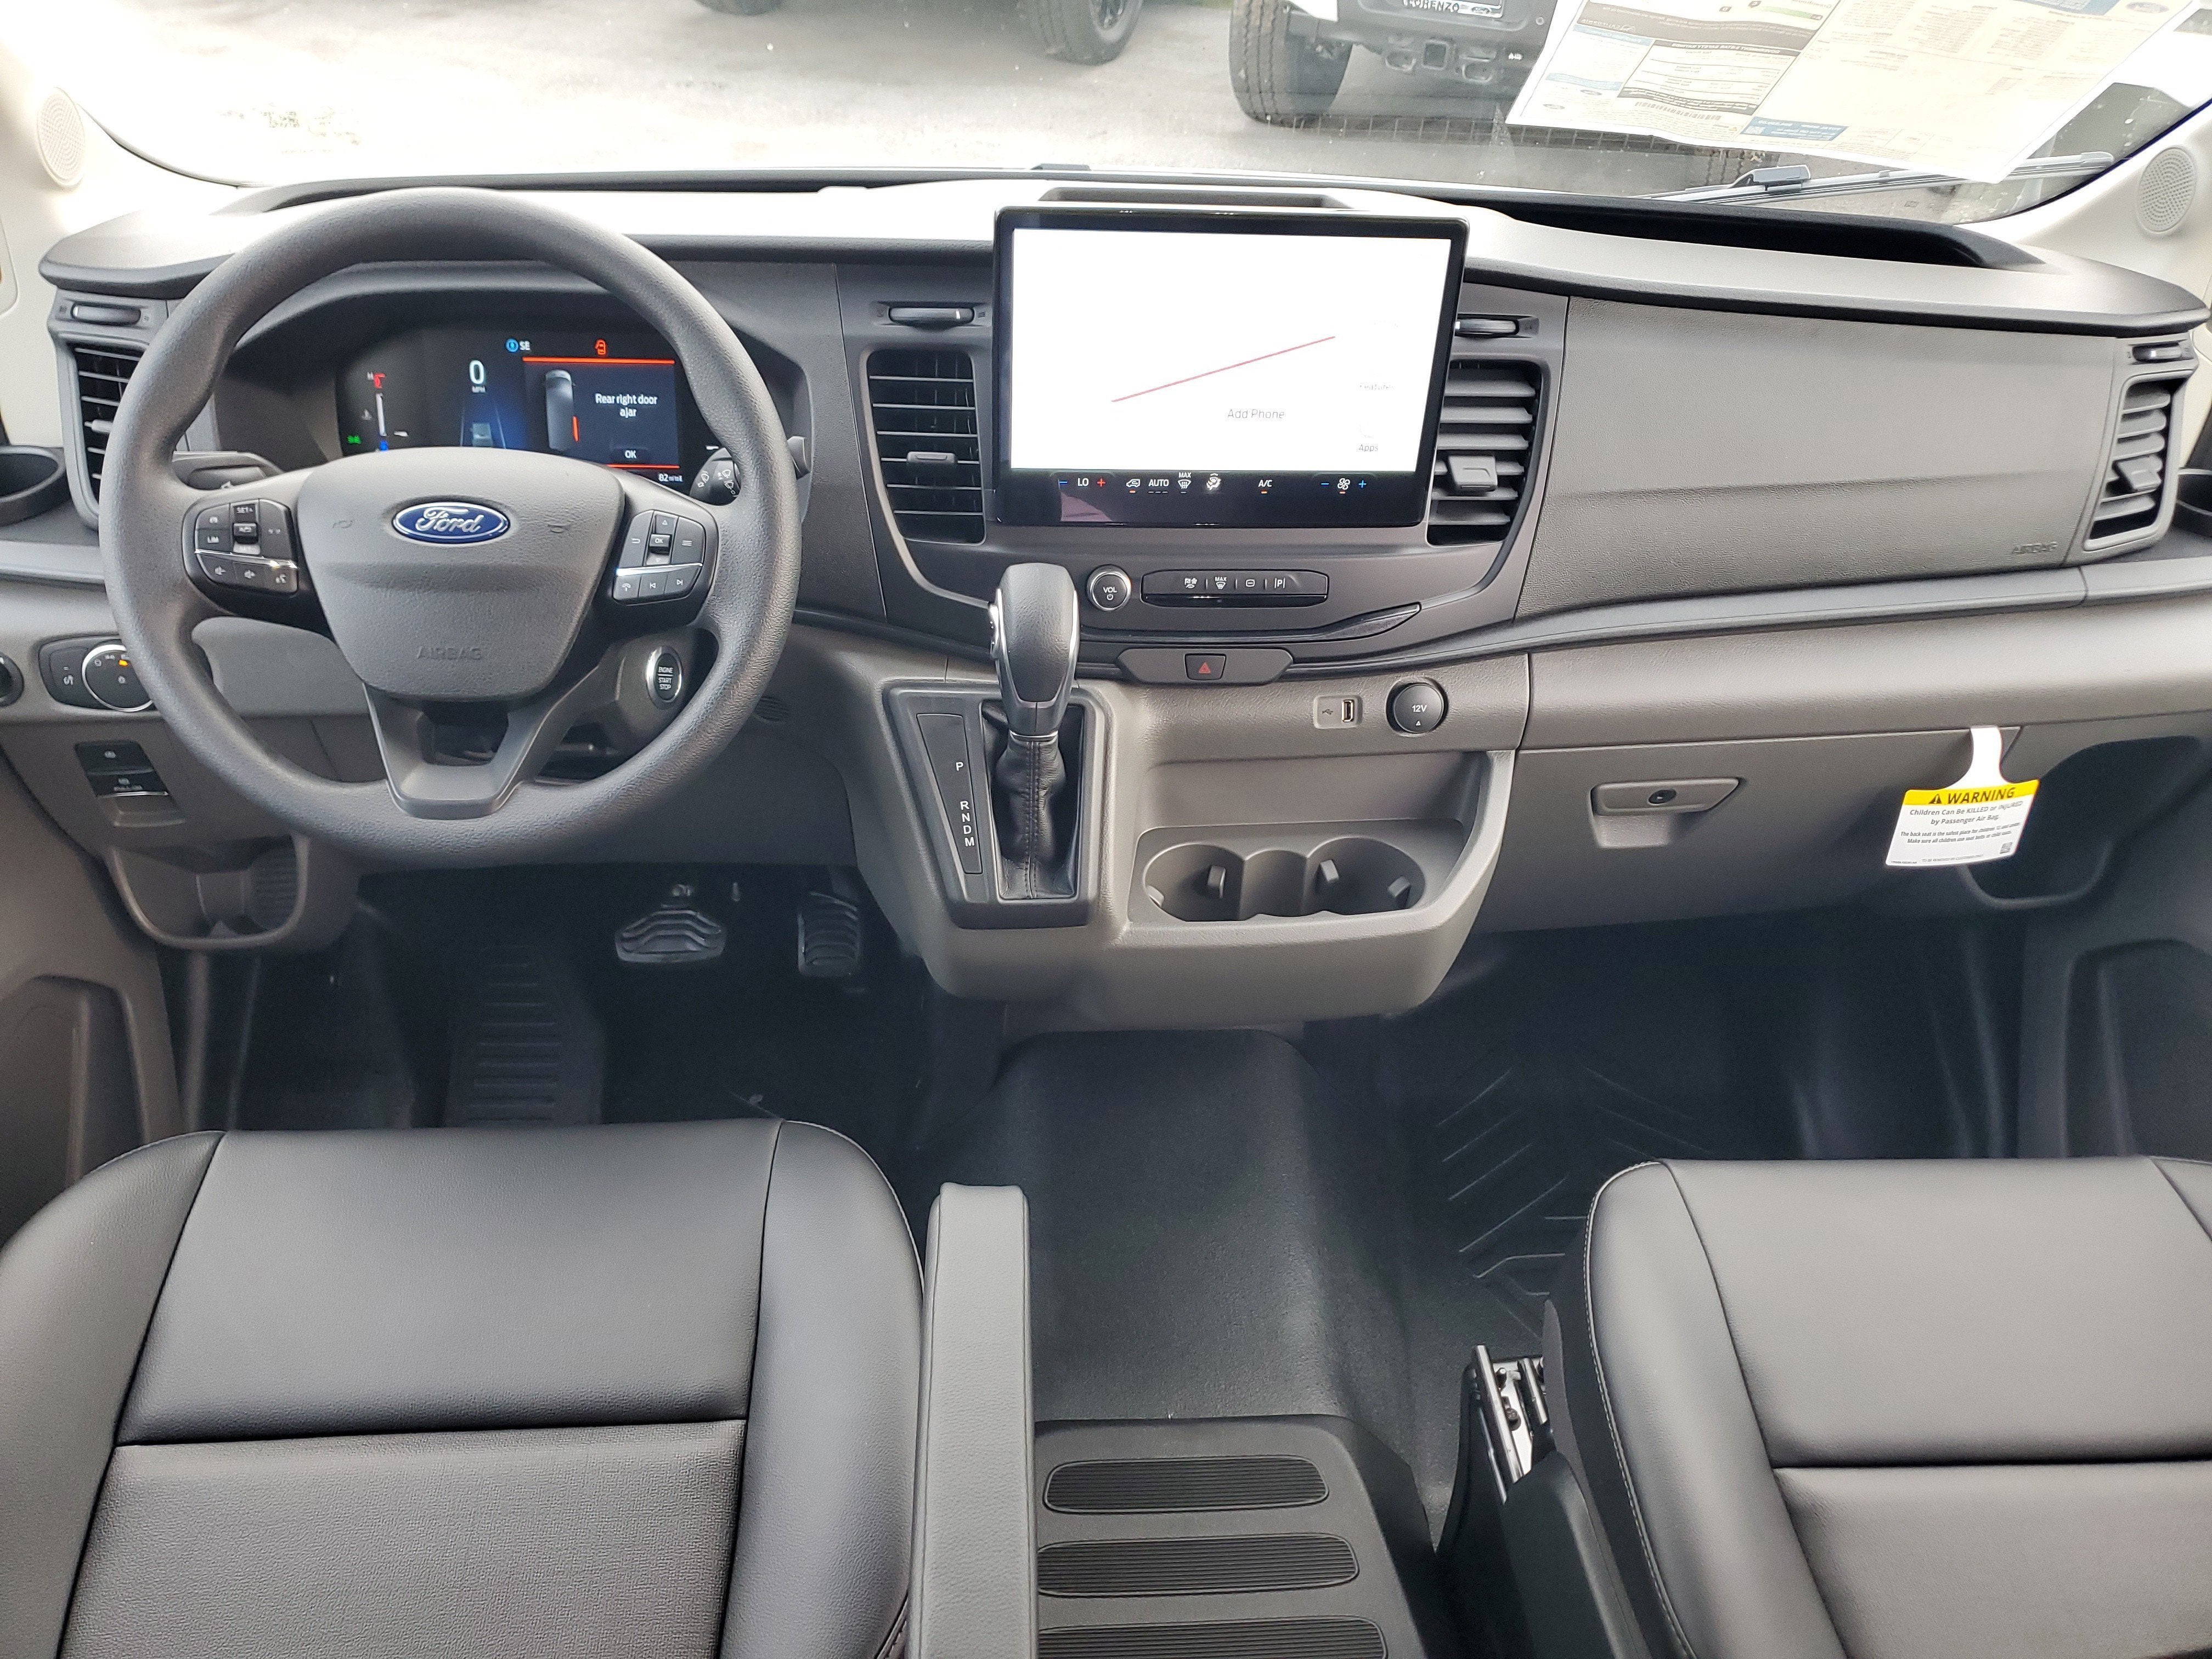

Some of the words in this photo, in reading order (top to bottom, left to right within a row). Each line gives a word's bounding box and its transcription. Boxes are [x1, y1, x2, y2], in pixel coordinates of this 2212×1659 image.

[470, 360, 484, 384] 0
[595, 393, 615, 404] Rear
[616, 394, 637, 405] right
[637, 394, 657, 404] door
[619, 407, 637, 418] ajar
[1227, 409, 1249, 419] Add
[1251, 409, 1285, 419] Phone
[1358, 444, 1379, 453] Apps
[625, 450, 637, 459] OK
[1077, 478, 1089, 487] LO
[1148, 479, 1169, 487] AUTO
[1258, 479, 1272, 488] A/C
[415, 506, 485, 533] Ford
[417, 646, 483, 660] AIRBAG
[1412, 704, 1427, 713] 12V
[956, 761, 964, 771] P
[1947, 788, 2016, 804] WARNING
[960, 801, 970, 810] R
[962, 812, 970, 822] N
[963, 825, 972, 834] D
[964, 837, 974, 847] M
